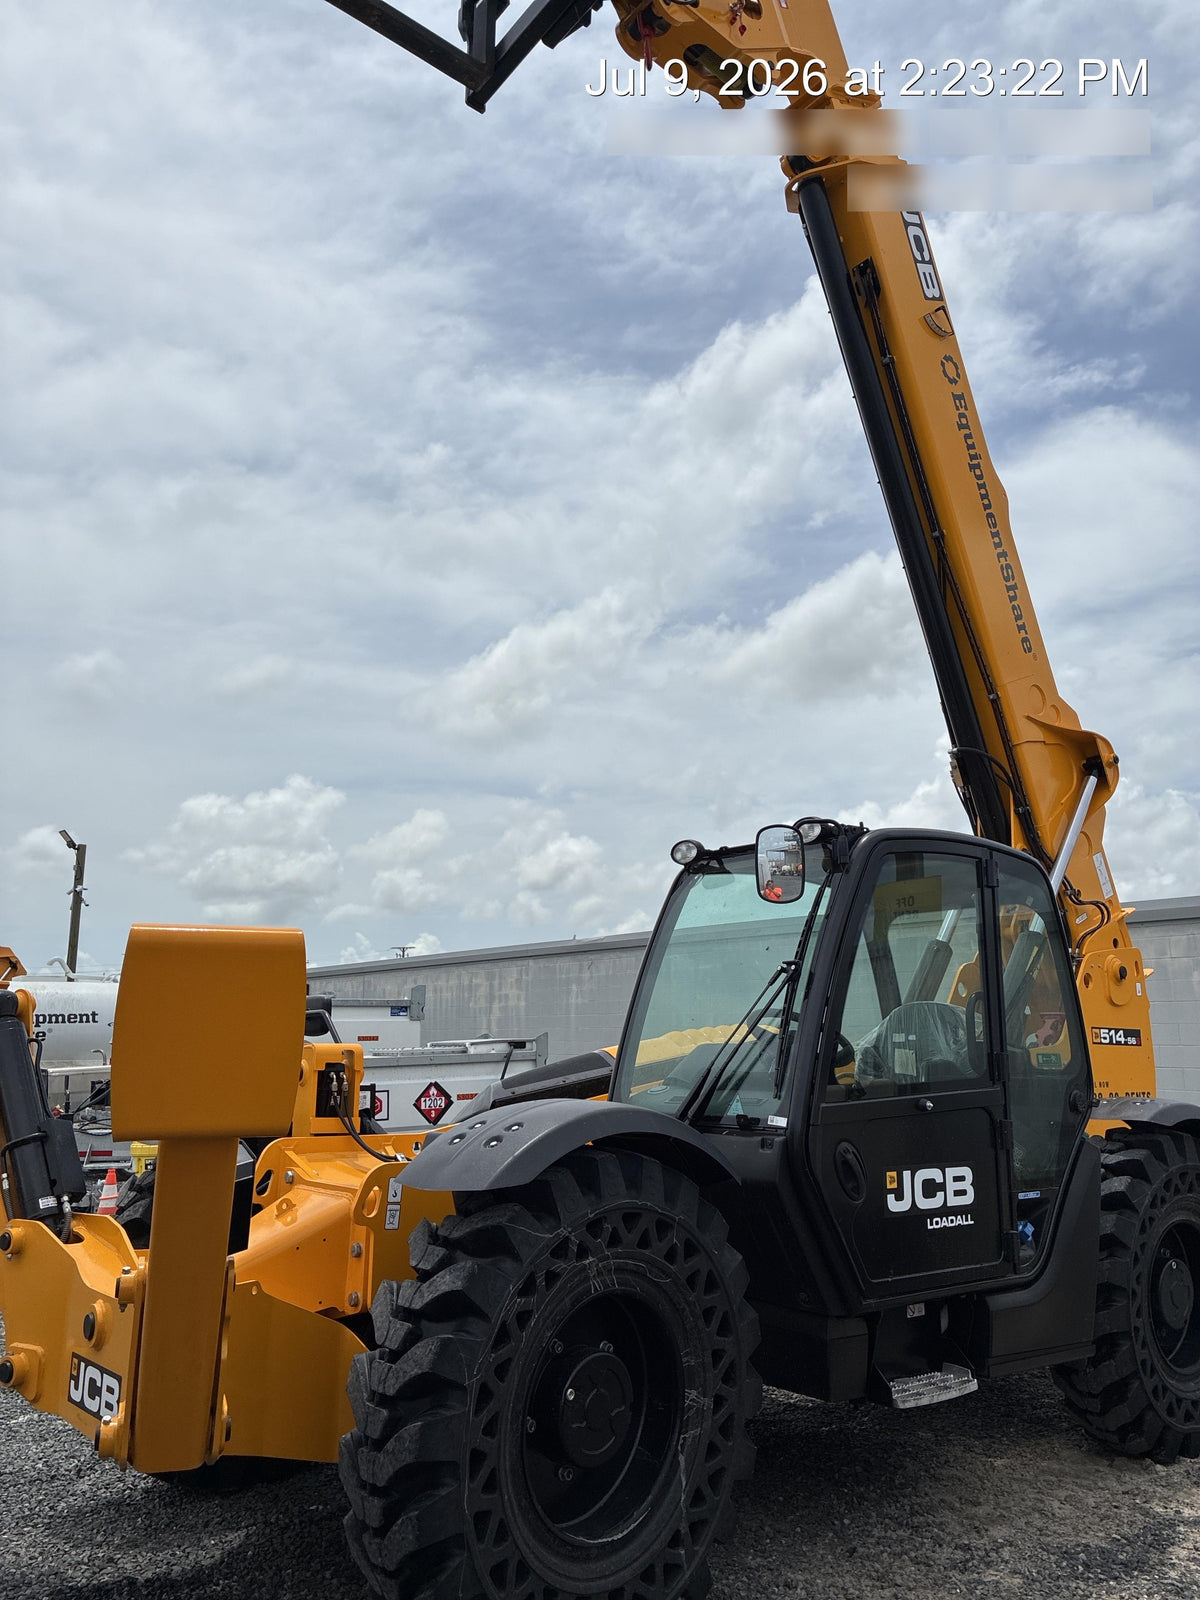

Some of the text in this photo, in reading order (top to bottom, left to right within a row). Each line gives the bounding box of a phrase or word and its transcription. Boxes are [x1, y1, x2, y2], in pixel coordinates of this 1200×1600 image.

[951, 391, 1034, 655] EquipmentShare
[33, 1011, 99, 1028] pment
[422, 1098, 444, 1109] 1202
[887, 1166, 975, 1213] JCB
[927, 1213, 975, 1230] LOADALL
[69, 1360, 120, 1418] JCB
